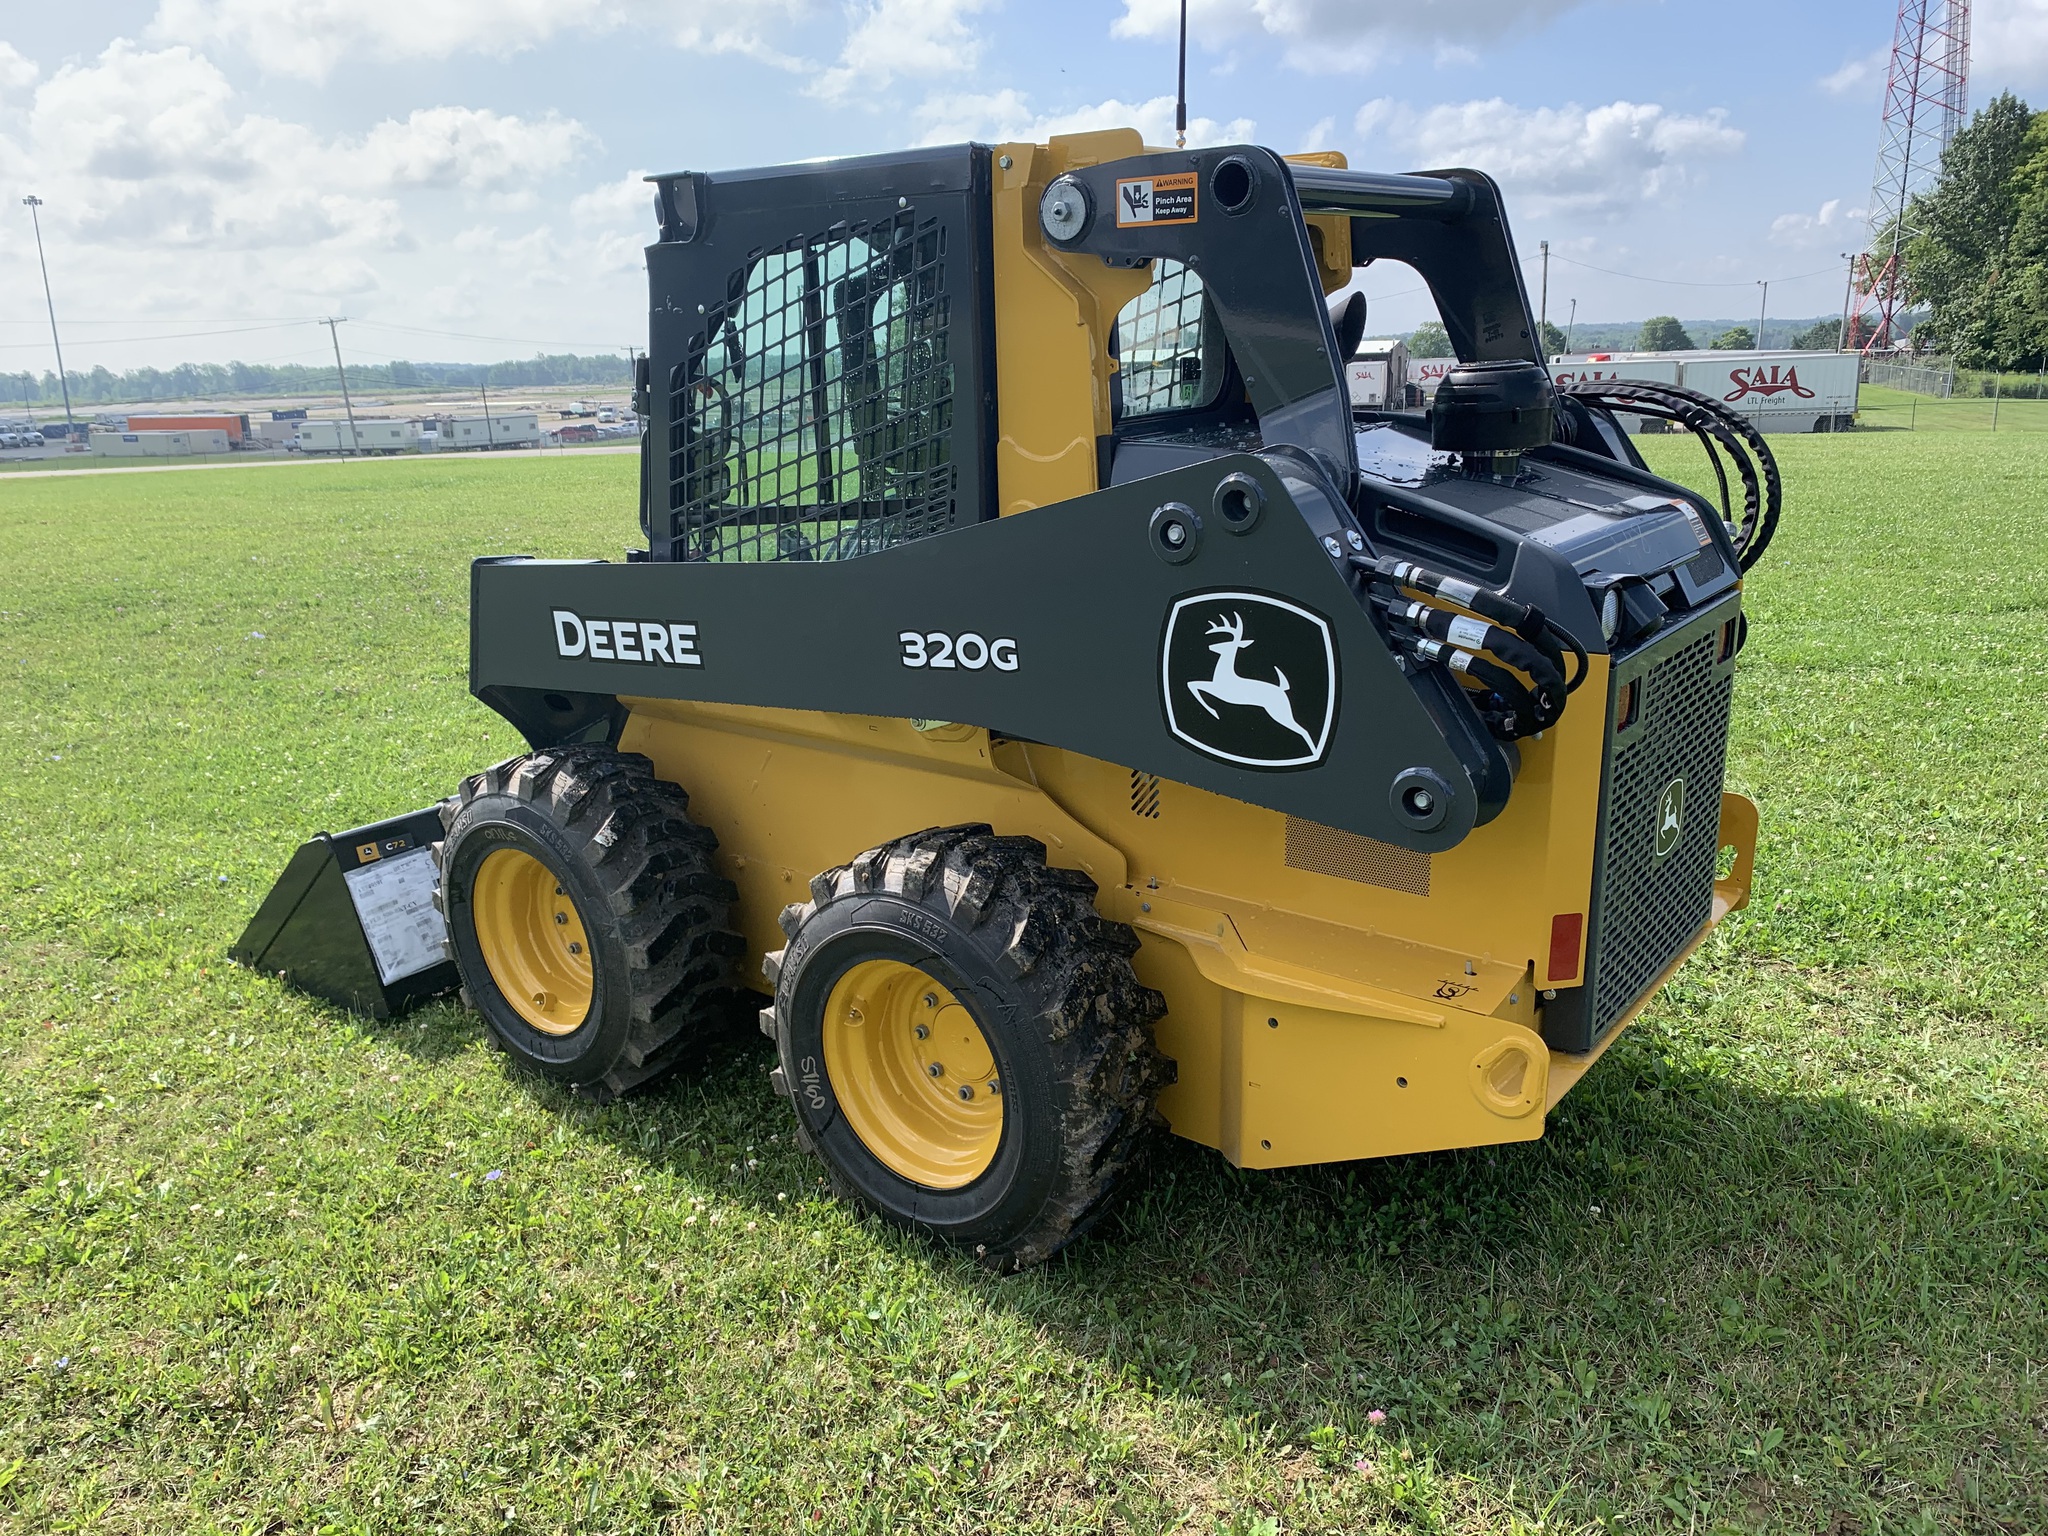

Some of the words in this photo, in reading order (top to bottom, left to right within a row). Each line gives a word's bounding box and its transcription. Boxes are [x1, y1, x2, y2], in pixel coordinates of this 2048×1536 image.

[1163, 177, 1194, 187] WARNING
[1155, 196, 1175, 205] Pinch
[1176, 195, 1192, 204] Area
[1155, 207, 1170, 216] Keep
[1171, 206, 1187, 215] Away
[1354, 371, 1375, 381] SAIA
[1724, 365, 1815, 402] SAIA
[1747, 396, 1759, 405] LTL
[1760, 395, 1786, 406] Freight
[553, 610, 701, 665] DEERE
[899, 631, 1019, 671] 320G
[385, 839, 406, 851] C72
[540, 822, 559, 846] SKS
[556, 839, 572, 862] 532
[899, 909, 924, 930] SKS
[922, 917, 949, 944] 532
